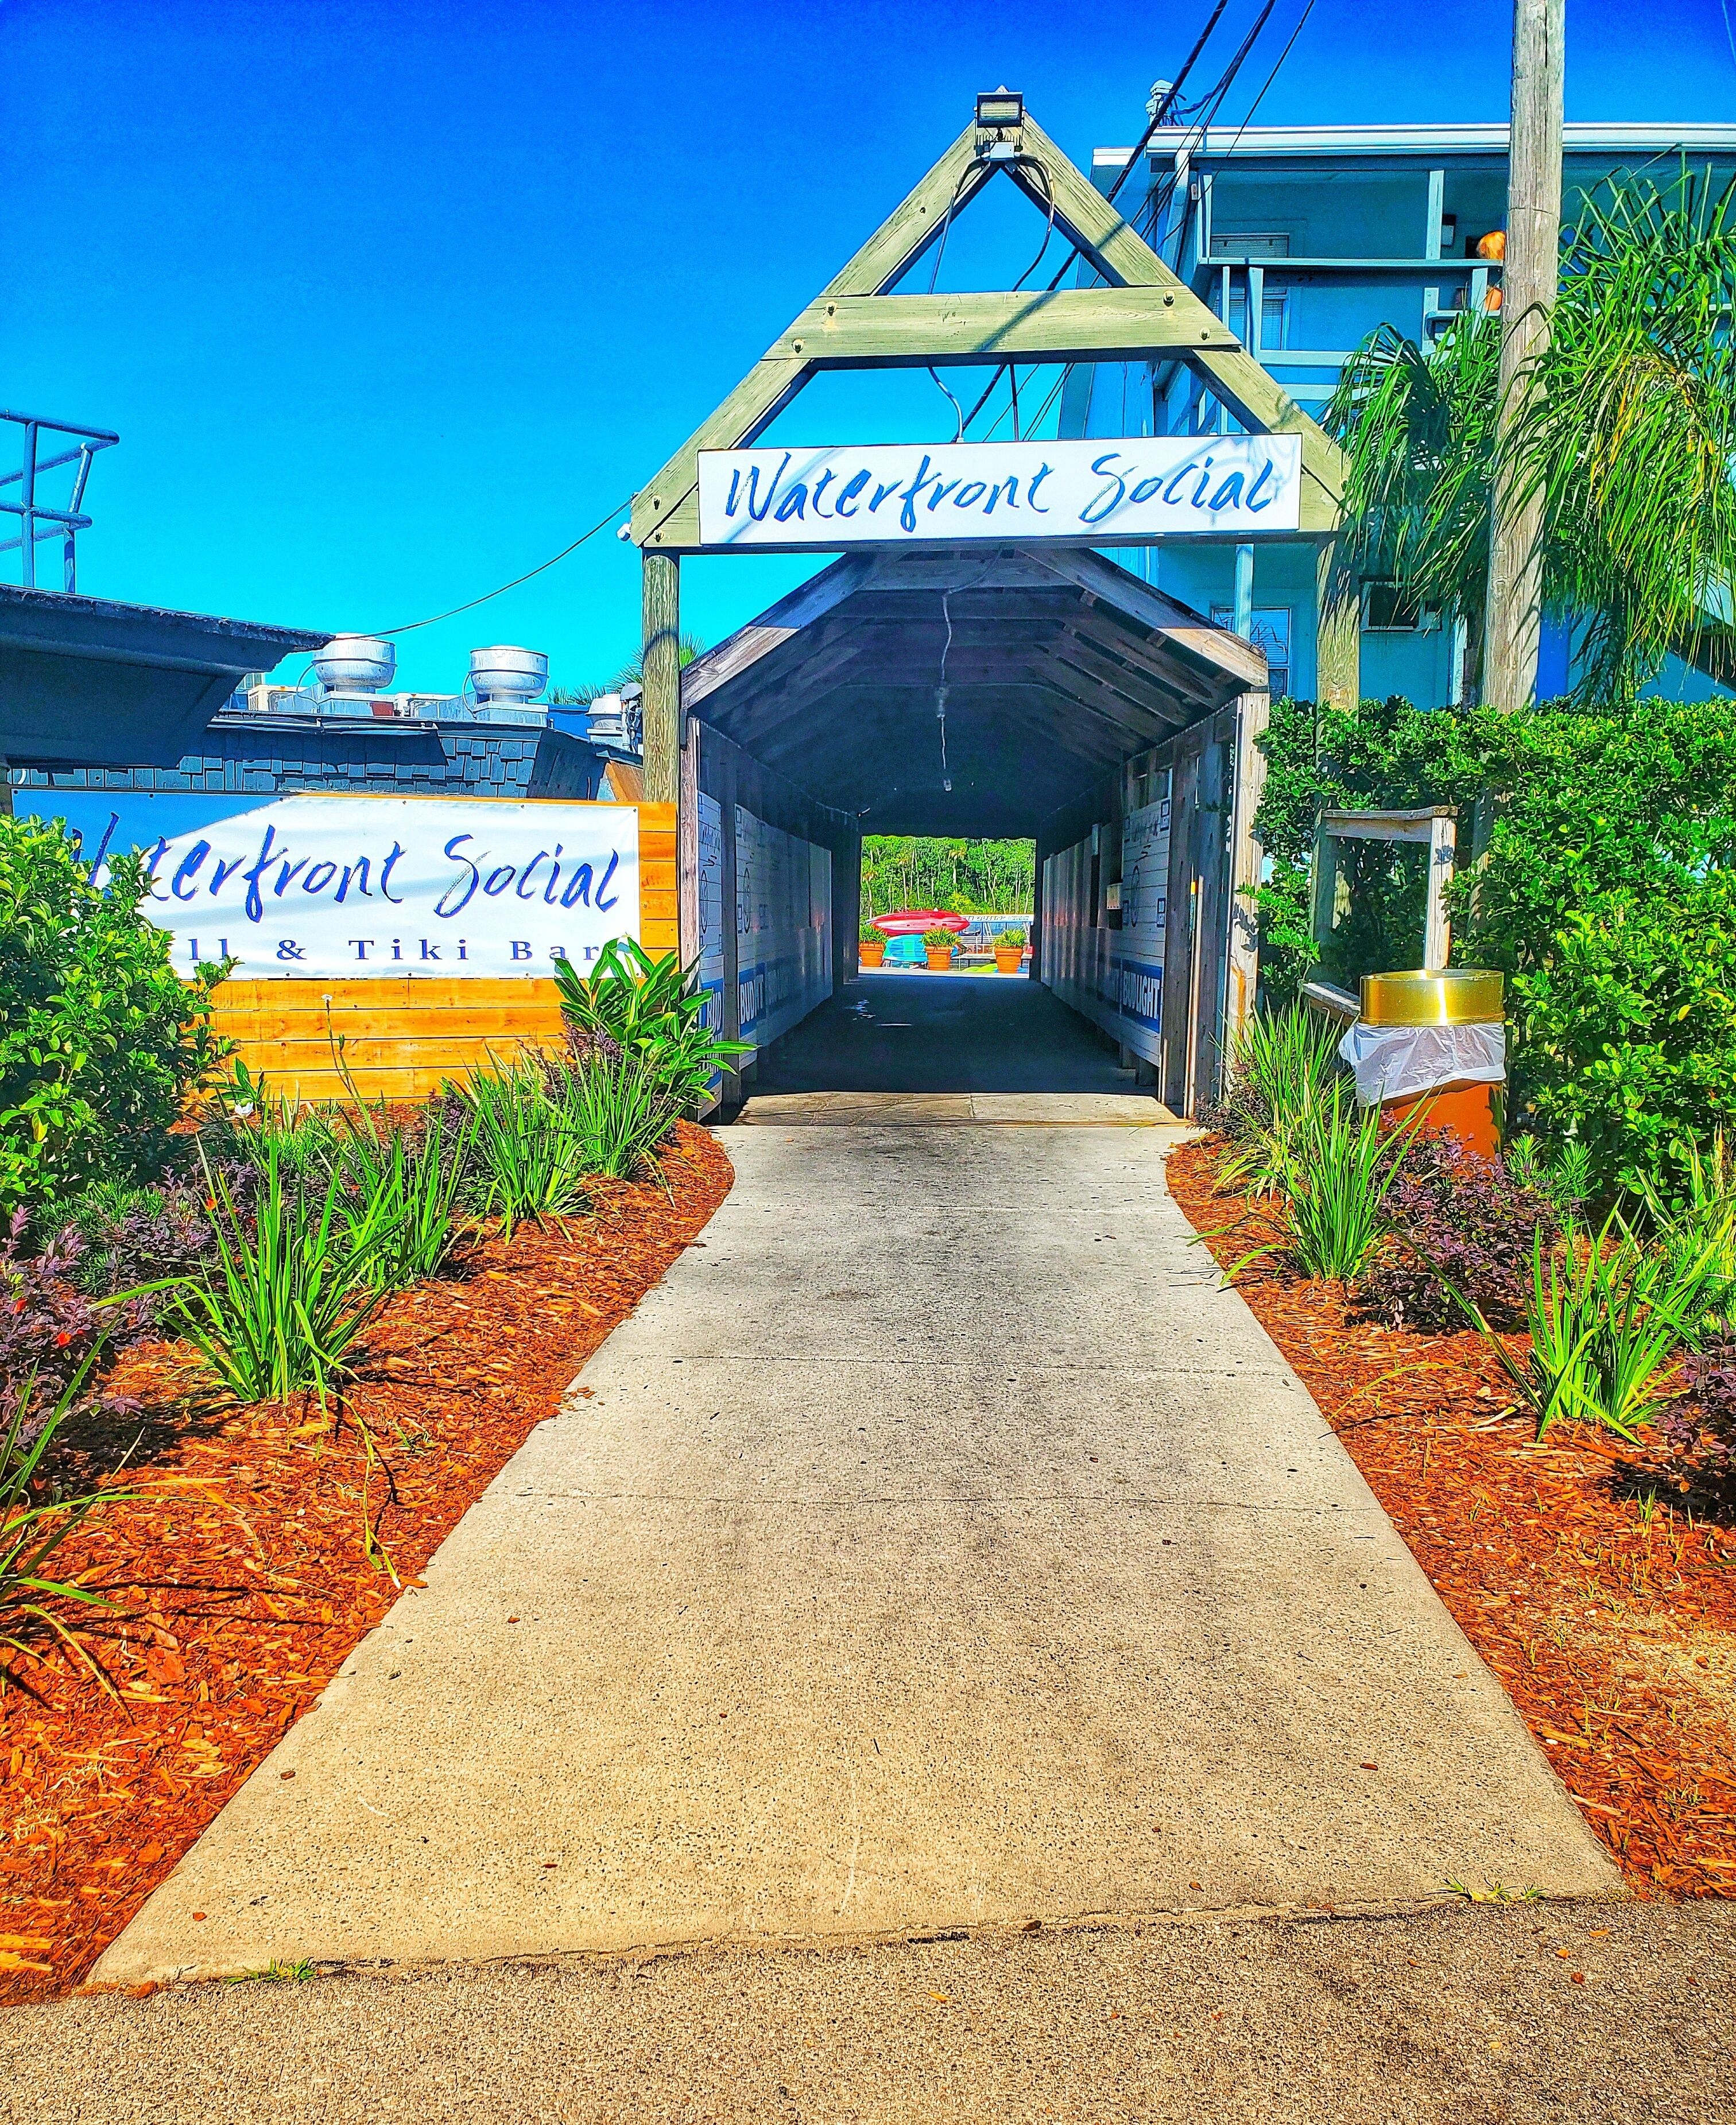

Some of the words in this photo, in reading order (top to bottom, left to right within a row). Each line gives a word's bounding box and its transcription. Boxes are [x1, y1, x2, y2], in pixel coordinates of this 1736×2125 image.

[725, 452, 1054, 532] Waterfront
[1078, 453, 1273, 523] Social
[434, 834, 619, 918] Social
[276, 940, 306, 962] &
[348, 939, 467, 961] Tiki
[510, 941, 599, 961] Bar
